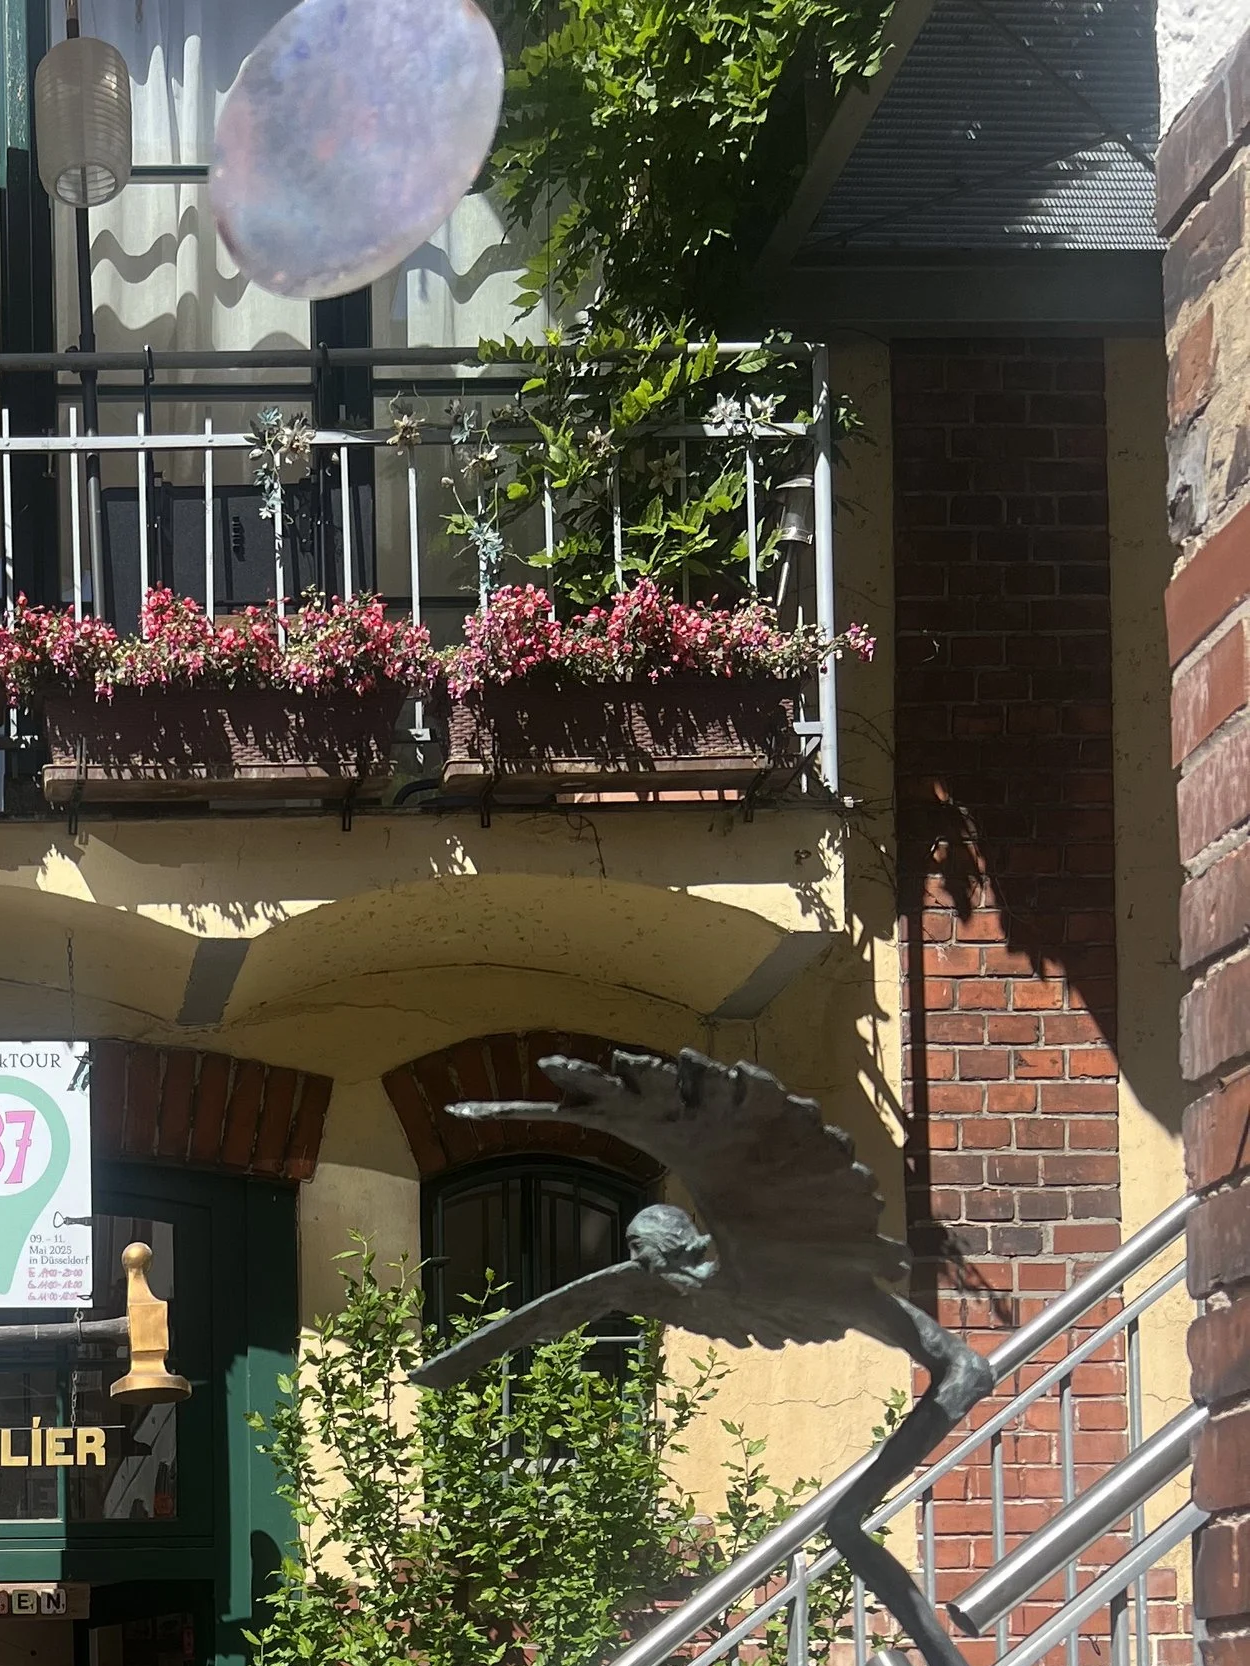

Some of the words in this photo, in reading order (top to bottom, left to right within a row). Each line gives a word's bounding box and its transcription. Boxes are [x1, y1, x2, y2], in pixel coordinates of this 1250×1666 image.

[29, 1234, 44, 1243] 09.
[53, 1235, 66, 1243] 11.
[29, 1246, 47, 1254] Mai
[49, 1246, 72, 1254] 2025
[41, 1255, 90, 1265] Düsseldorf
